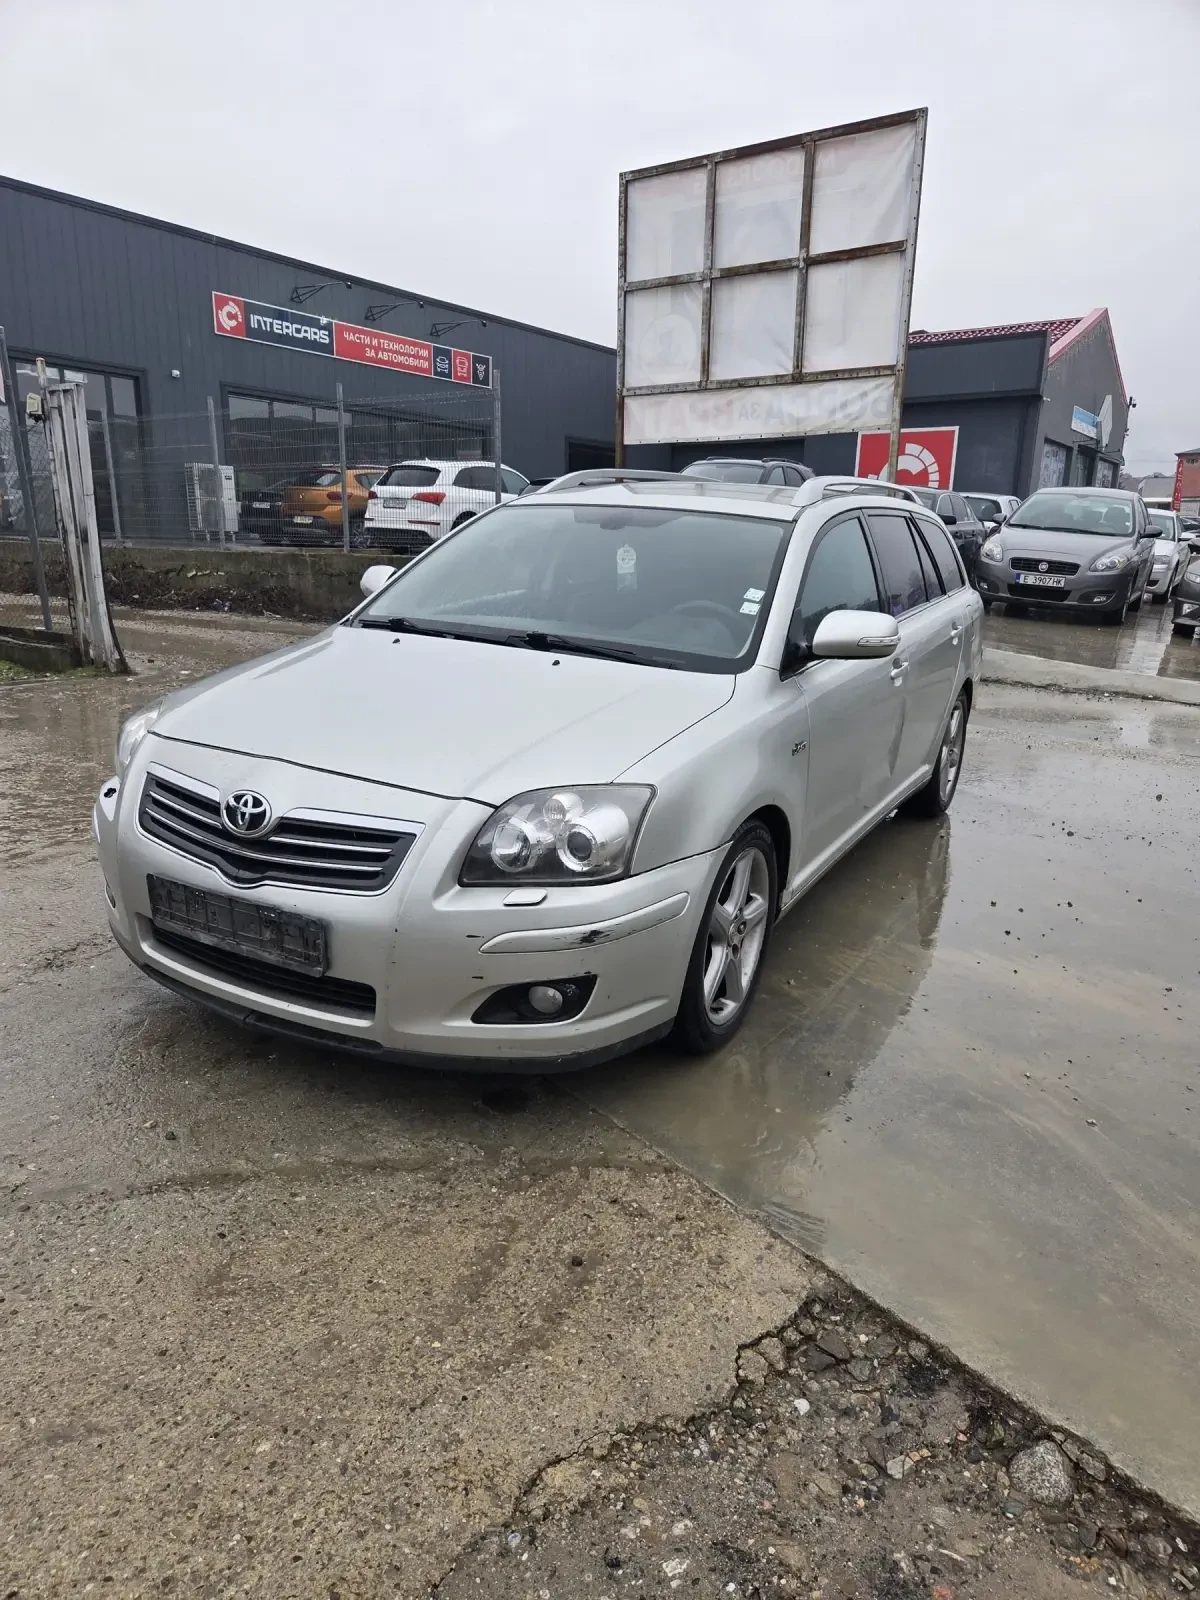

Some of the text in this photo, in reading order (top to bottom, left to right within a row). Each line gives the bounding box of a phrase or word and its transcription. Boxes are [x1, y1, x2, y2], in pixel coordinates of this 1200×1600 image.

[250, 313, 330, 344] INTERCARS
[343, 331, 429, 358] ЧАСТИ И ТЕХНОЛОГИИ
[365, 348, 429, 369] ЗА АВТОМОБИЛИ
[1032, 576, 1052, 585] 3907
